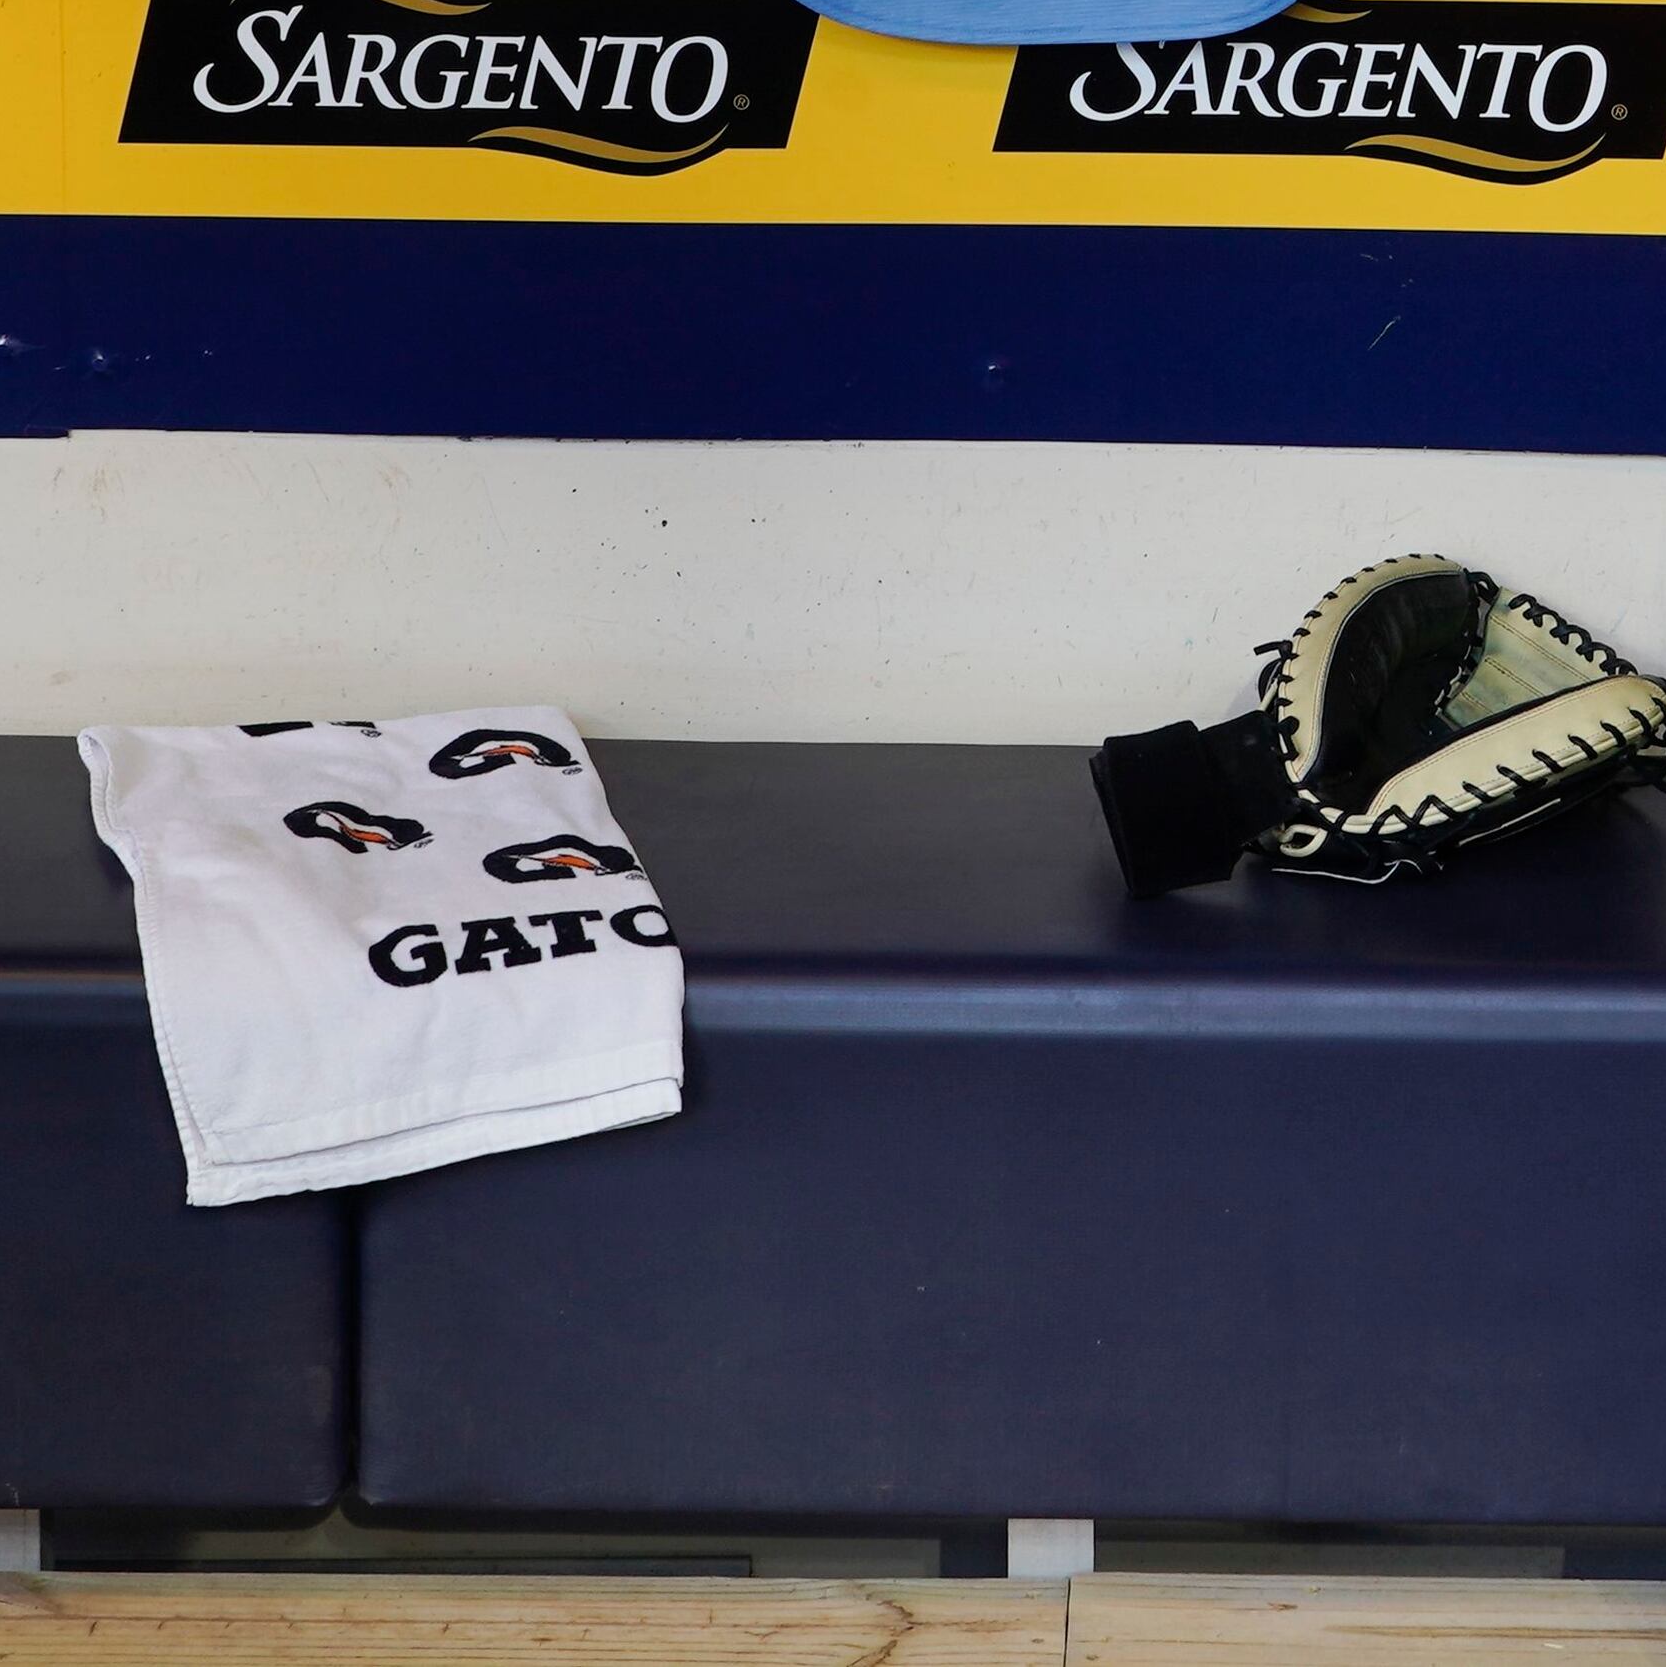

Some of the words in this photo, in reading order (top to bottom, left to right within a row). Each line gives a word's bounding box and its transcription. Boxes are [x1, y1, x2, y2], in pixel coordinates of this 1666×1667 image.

[193, 5, 728, 123] SARGENTO
[1069, 40, 1607, 133] SARGENTO
[368, 904, 680, 987] GATO
